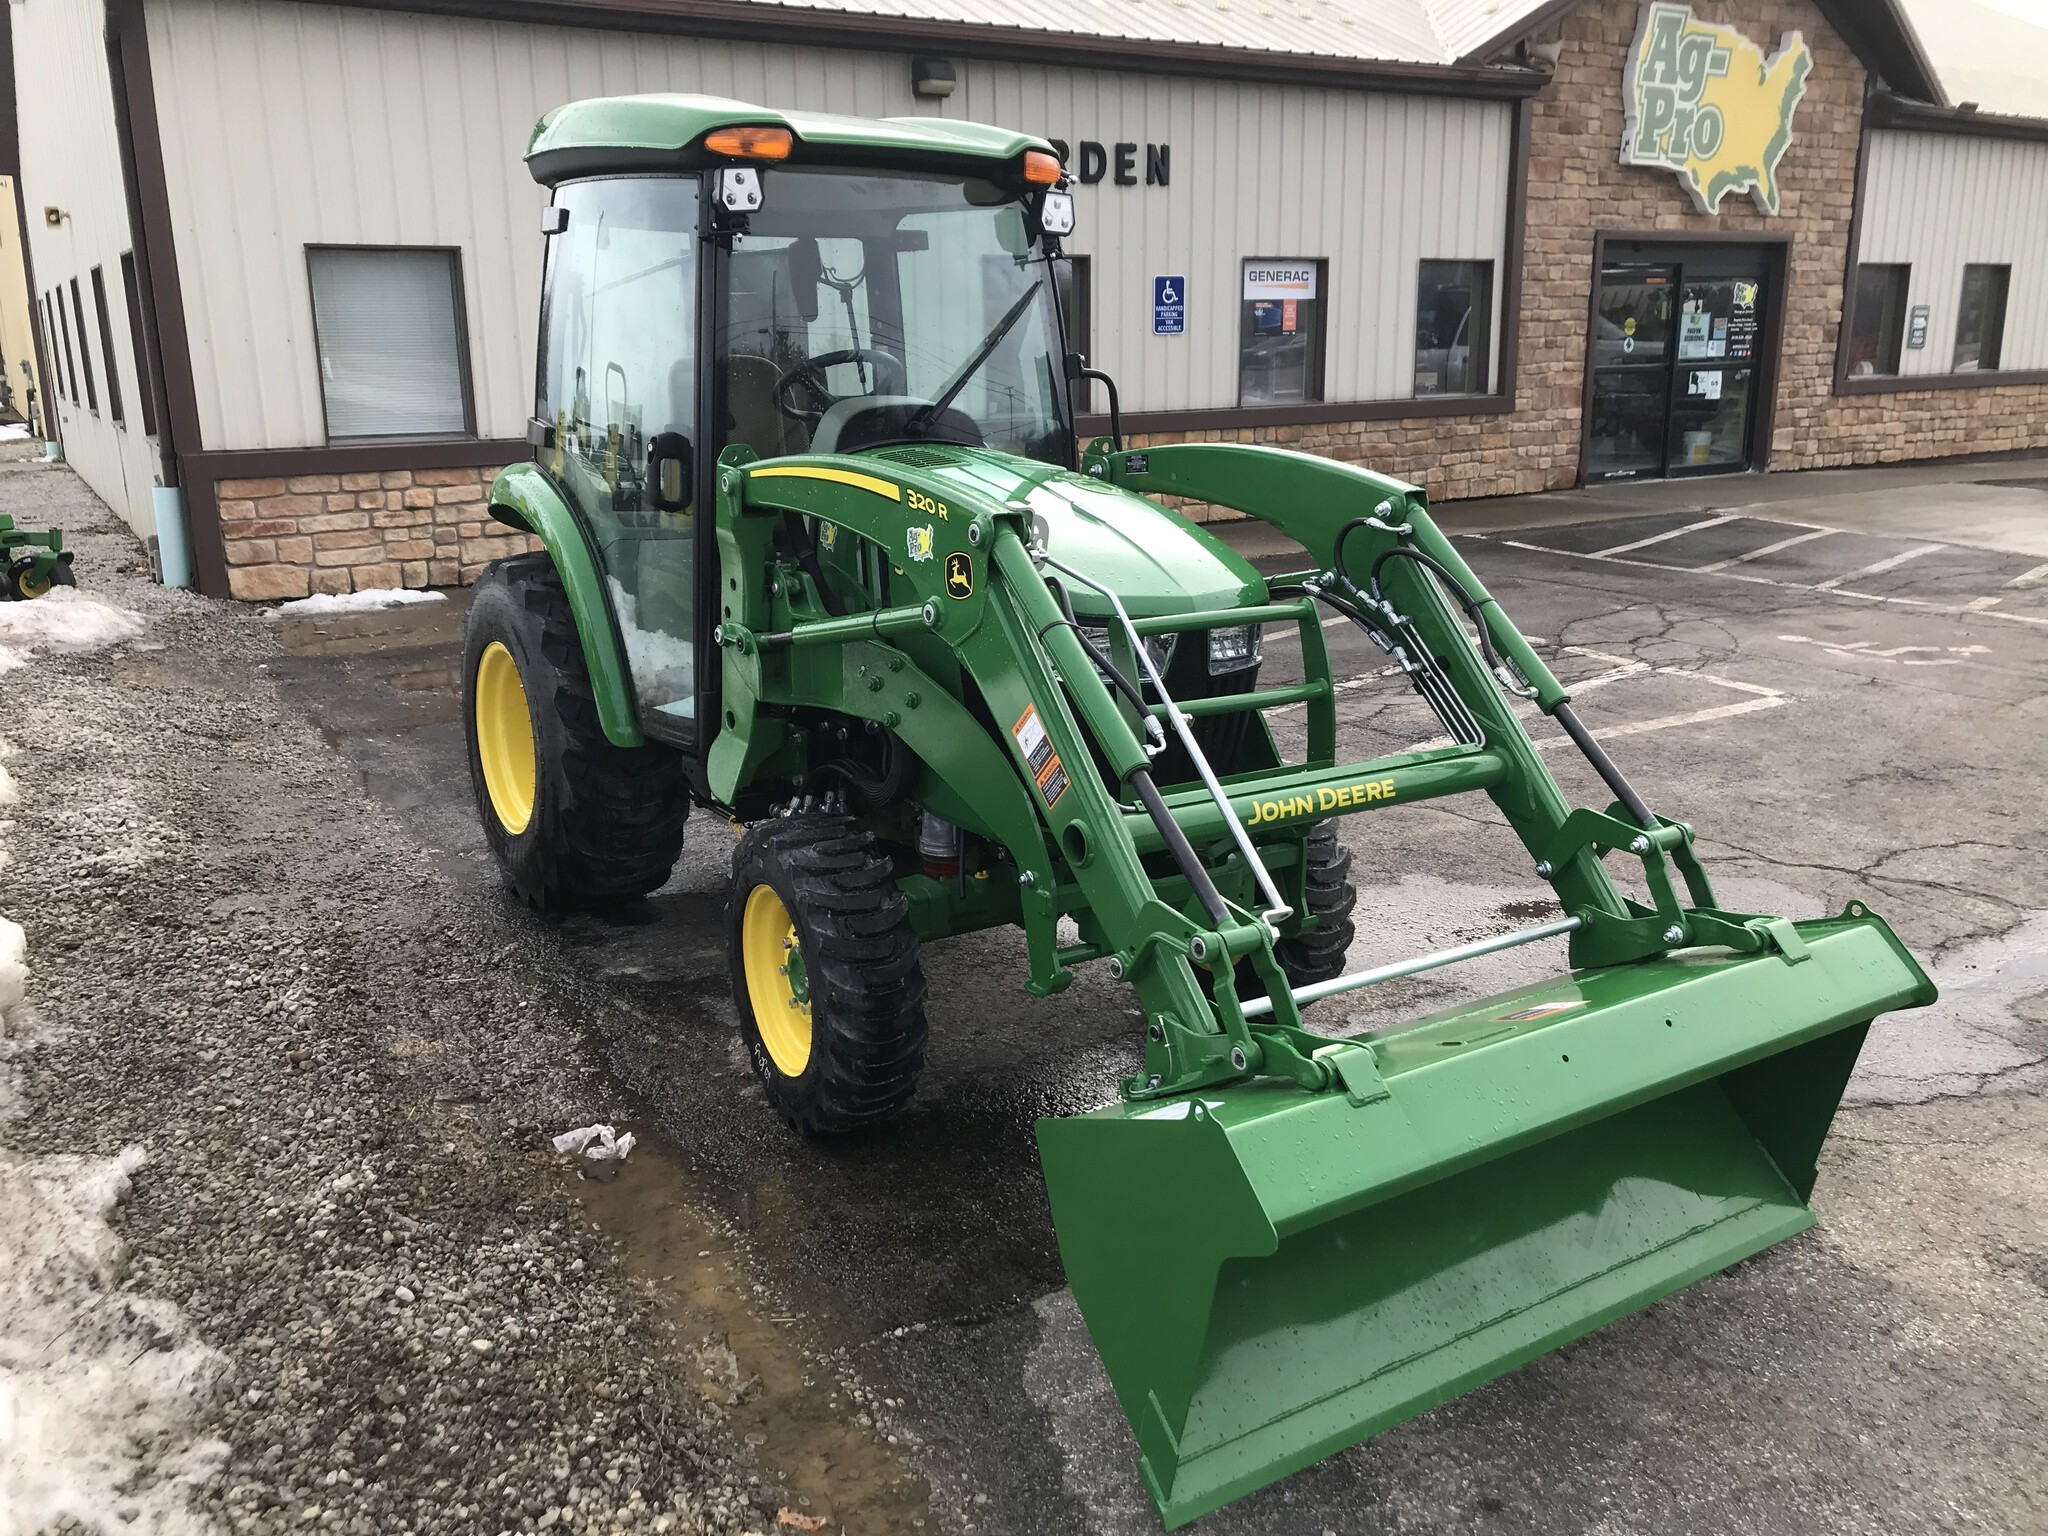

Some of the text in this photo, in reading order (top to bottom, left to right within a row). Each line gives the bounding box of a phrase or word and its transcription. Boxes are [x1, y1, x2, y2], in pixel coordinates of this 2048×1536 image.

[1639, 9, 1731, 104] Ag-
[1633, 83, 1724, 161] Pro
[1248, 270, 1309, 282] GENERAC
[906, 488, 949, 522] 320 R
[909, 542, 922, 555] Pro
[1247, 778, 1397, 826] JOHN DEERE
